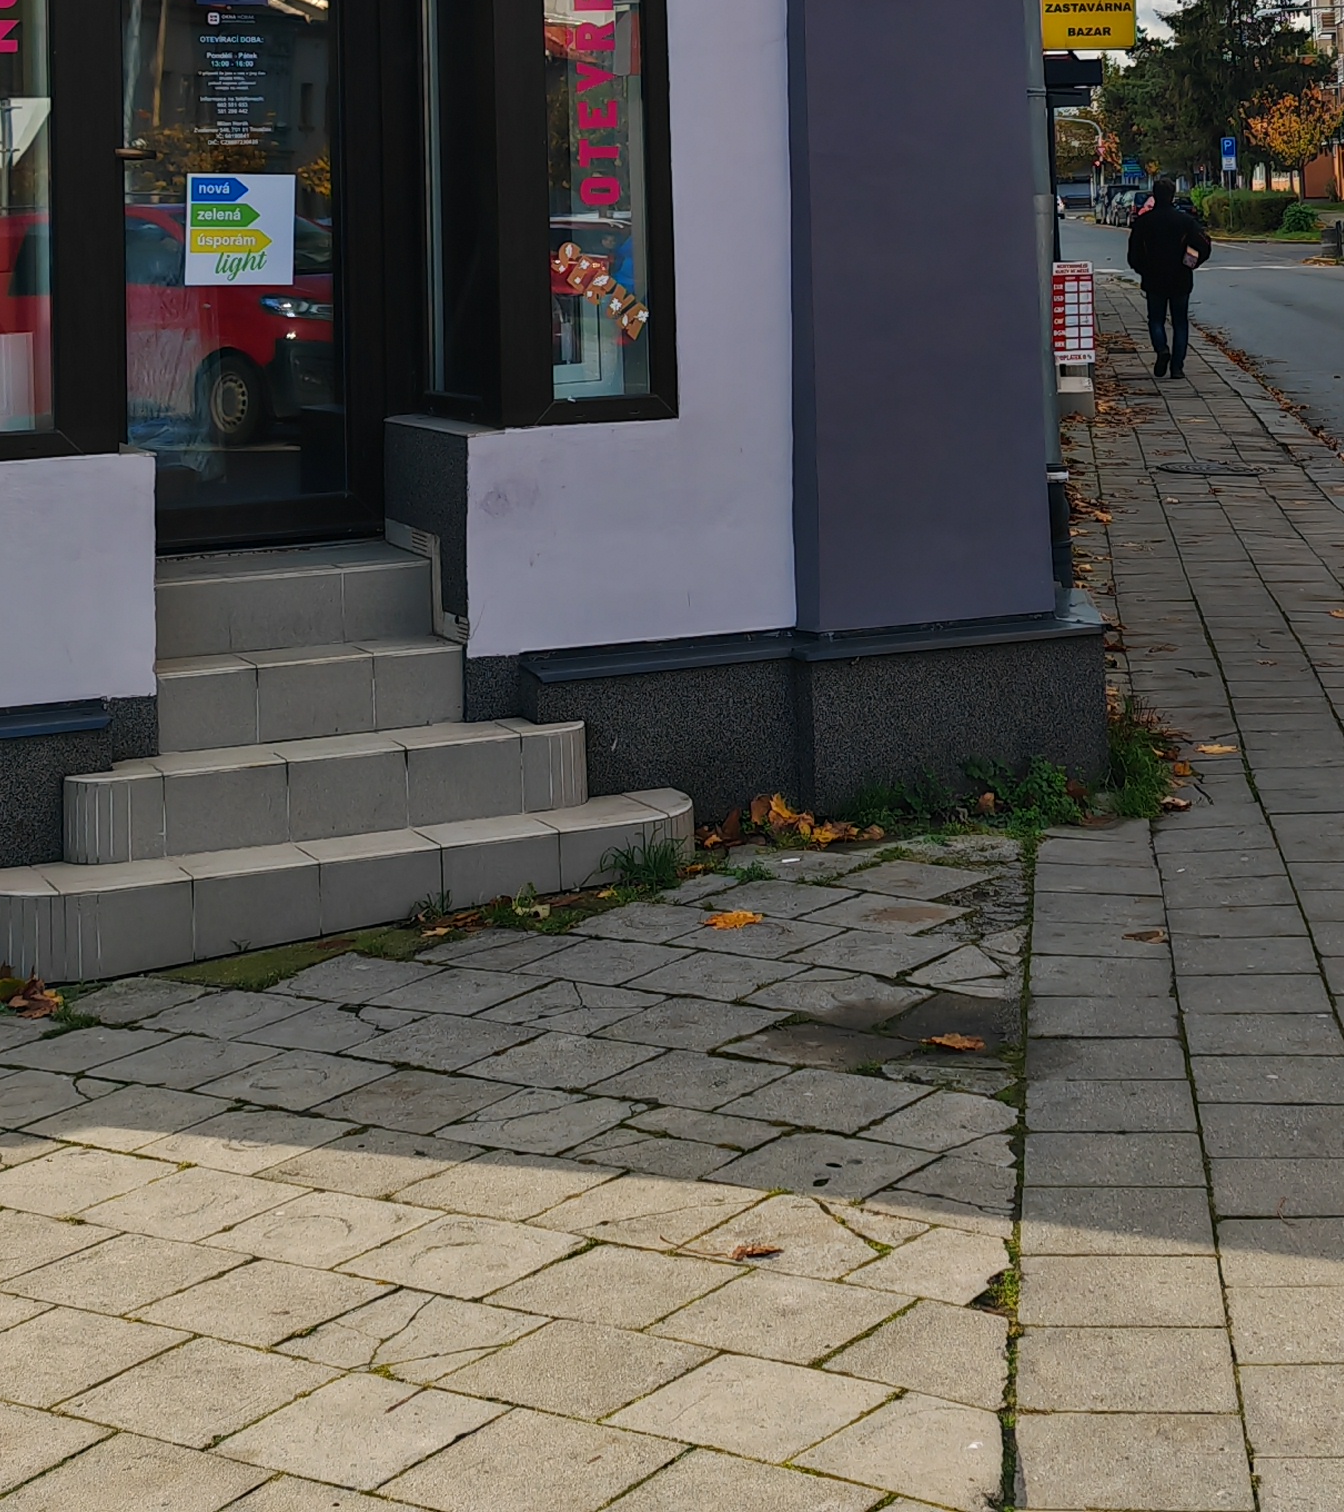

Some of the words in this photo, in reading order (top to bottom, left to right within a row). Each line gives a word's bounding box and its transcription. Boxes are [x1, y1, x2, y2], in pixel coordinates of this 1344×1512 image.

[1045, 0, 1132, 13] ZASTAVÁRNA
[1067, 27, 1111, 37] BAZAR
[198, 182, 230, 194] nová
[197, 208, 241, 221] zelená
[197, 233, 256, 248] úsporám
[215, 248, 268, 282] light
